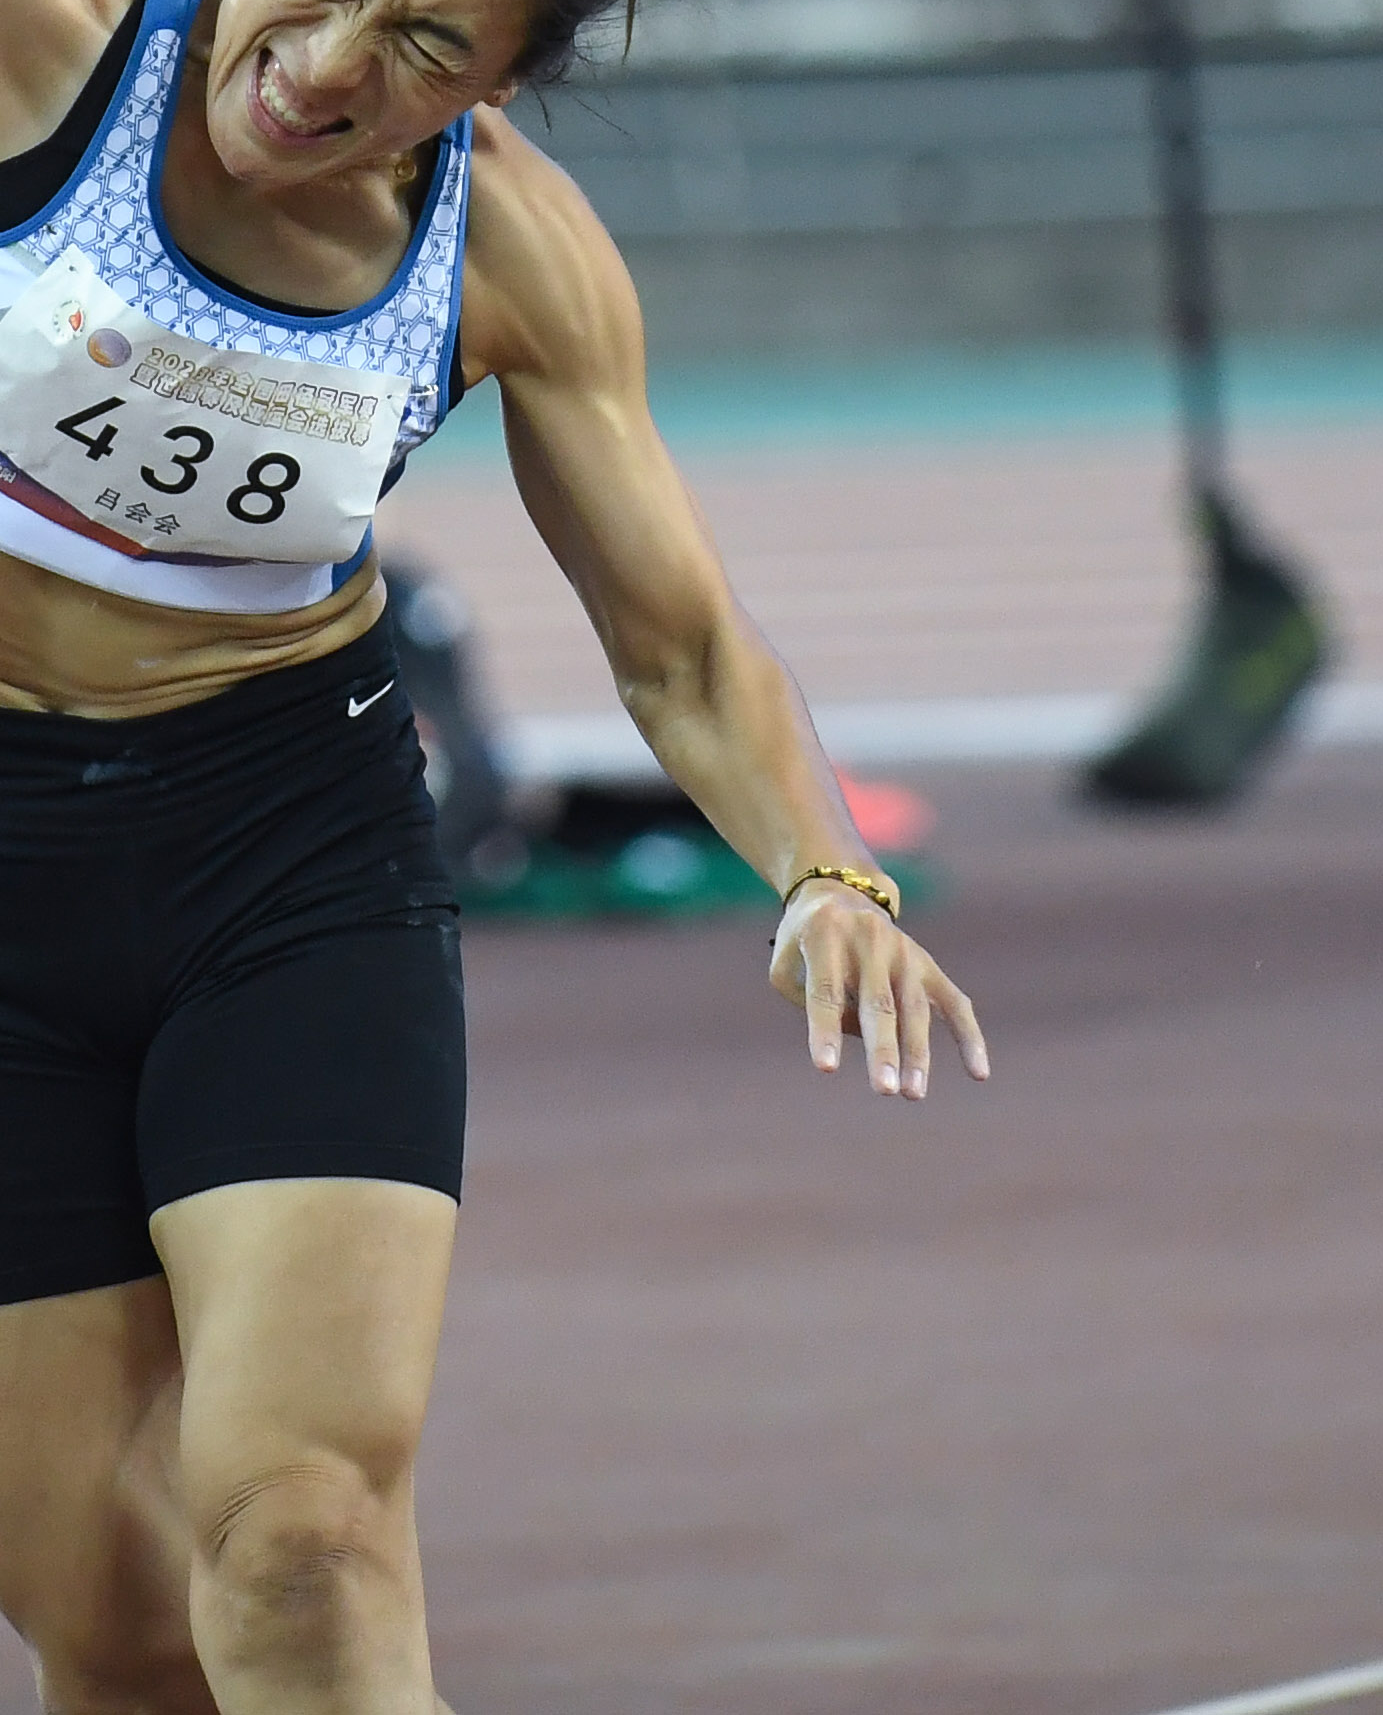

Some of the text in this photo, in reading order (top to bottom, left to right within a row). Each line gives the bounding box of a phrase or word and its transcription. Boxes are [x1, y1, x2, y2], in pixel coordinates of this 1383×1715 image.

[54, 396, 301, 525] 438
[95, 487, 181, 535] 吕会会
